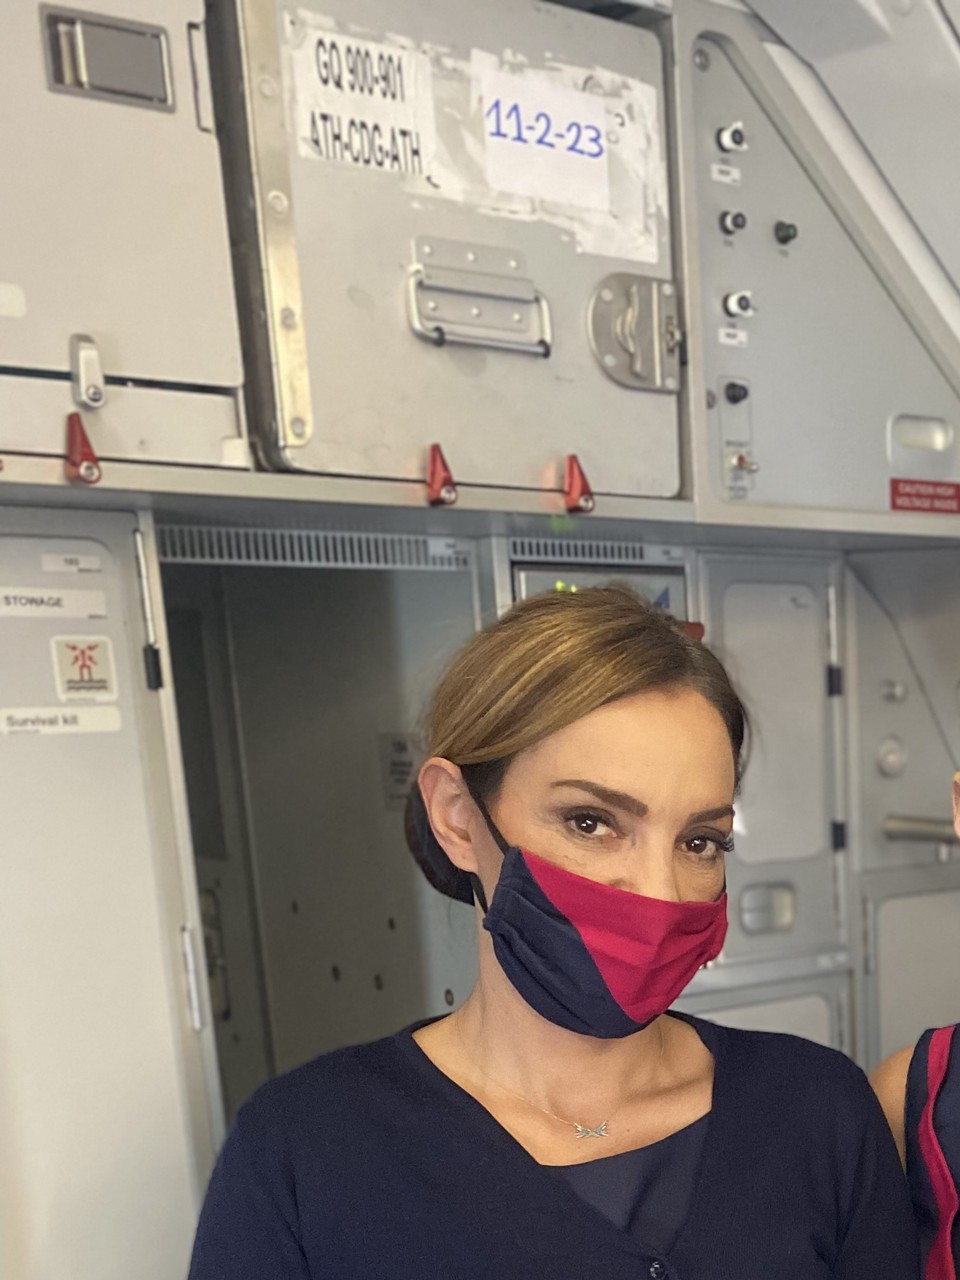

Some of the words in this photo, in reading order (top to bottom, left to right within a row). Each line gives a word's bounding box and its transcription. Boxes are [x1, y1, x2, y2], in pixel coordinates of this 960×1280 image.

[316, 38, 344, 92] GQ
[346, 45, 405, 102] 900-901
[311, 111, 422, 174] ATH-CDG-ATH
[486, 98, 604, 158] 11-2-23
[4, 595, 63, 608] STOWAGE
[6, 714, 59, 728] Survival
[62, 714, 78, 726] kit
